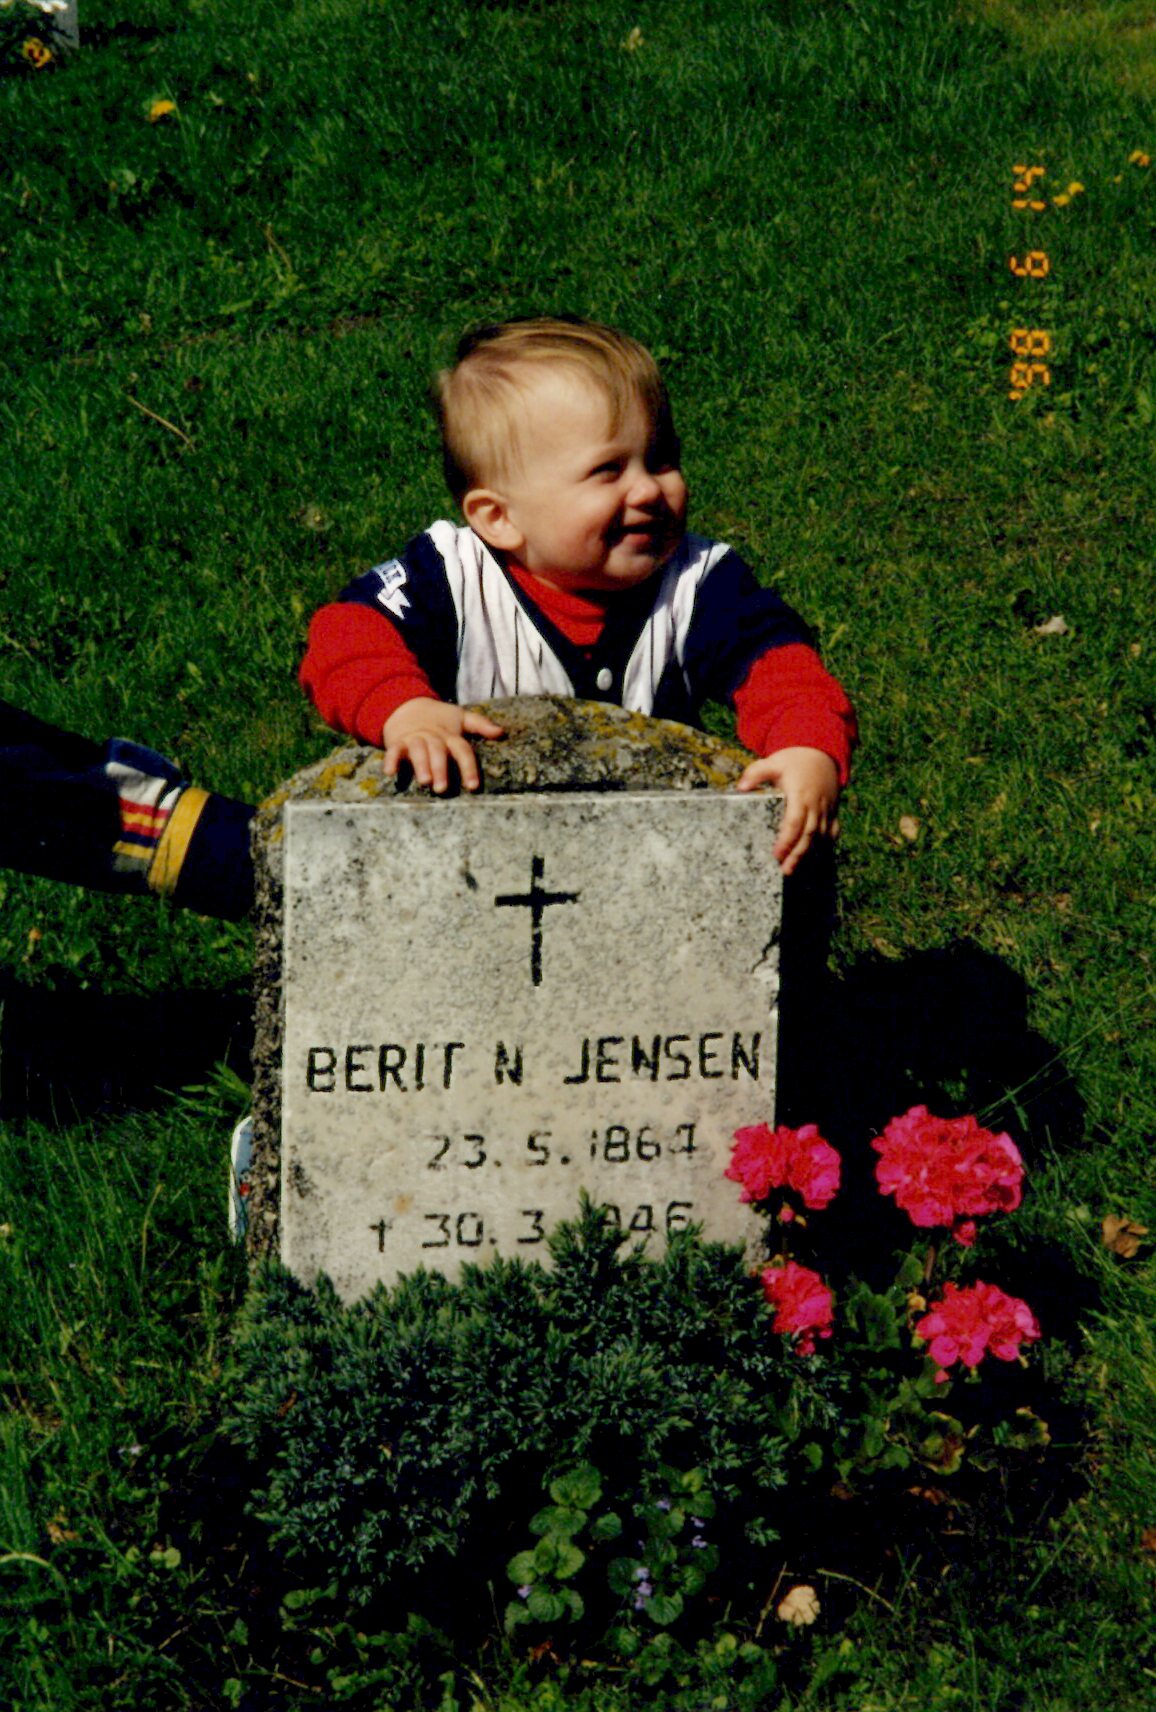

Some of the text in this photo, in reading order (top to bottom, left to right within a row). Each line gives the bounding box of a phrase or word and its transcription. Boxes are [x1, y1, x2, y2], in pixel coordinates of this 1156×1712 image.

[306, 1032, 762, 1093] BERIT N JENSEN
